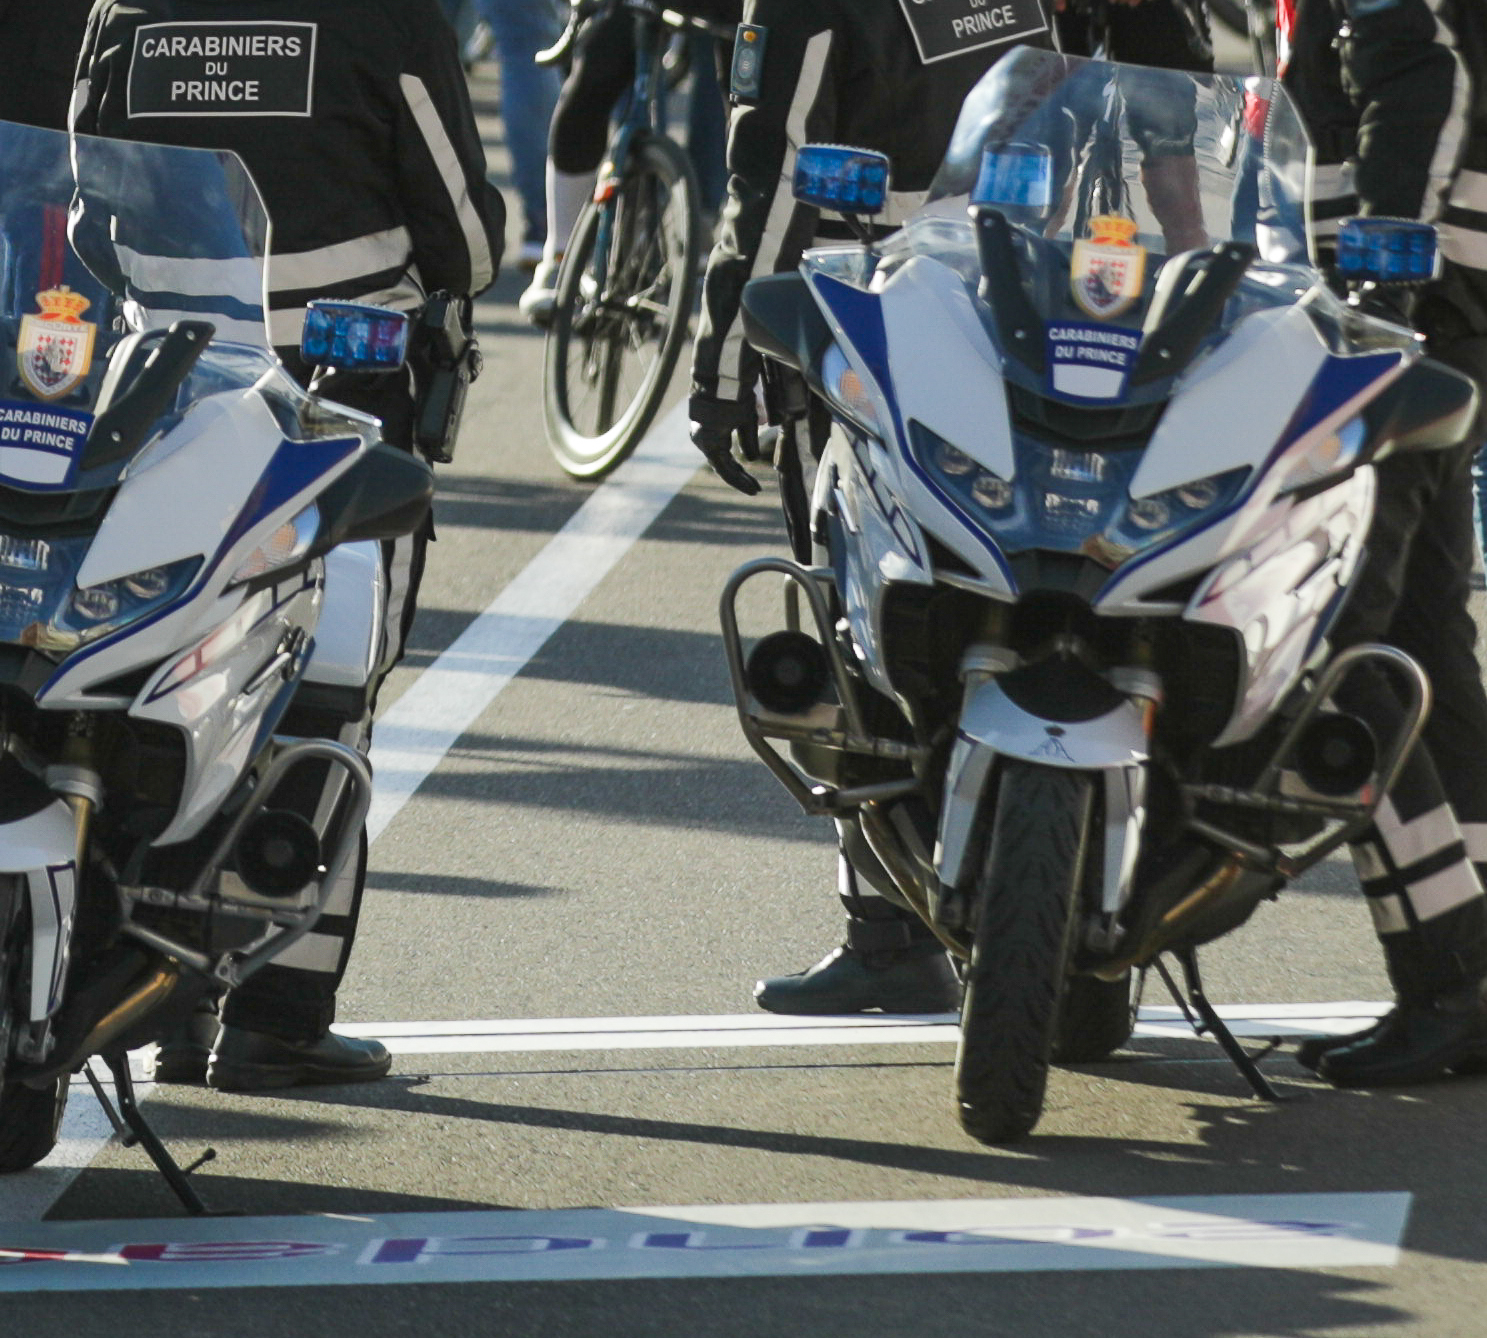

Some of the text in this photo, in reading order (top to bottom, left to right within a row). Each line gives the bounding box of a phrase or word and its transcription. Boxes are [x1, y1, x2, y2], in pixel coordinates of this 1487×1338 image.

[951, 5, 1016, 39] PRINCE
[141, 35, 302, 59] CARABINIERS
[204, 61, 228, 76] DU
[170, 80, 260, 102] PRINCE
[1049, 328, 1138, 350] CARABINIERS
[1055, 345, 1128, 366] DU PRINCE
[1, 427, 75, 451] DU PRINCE
